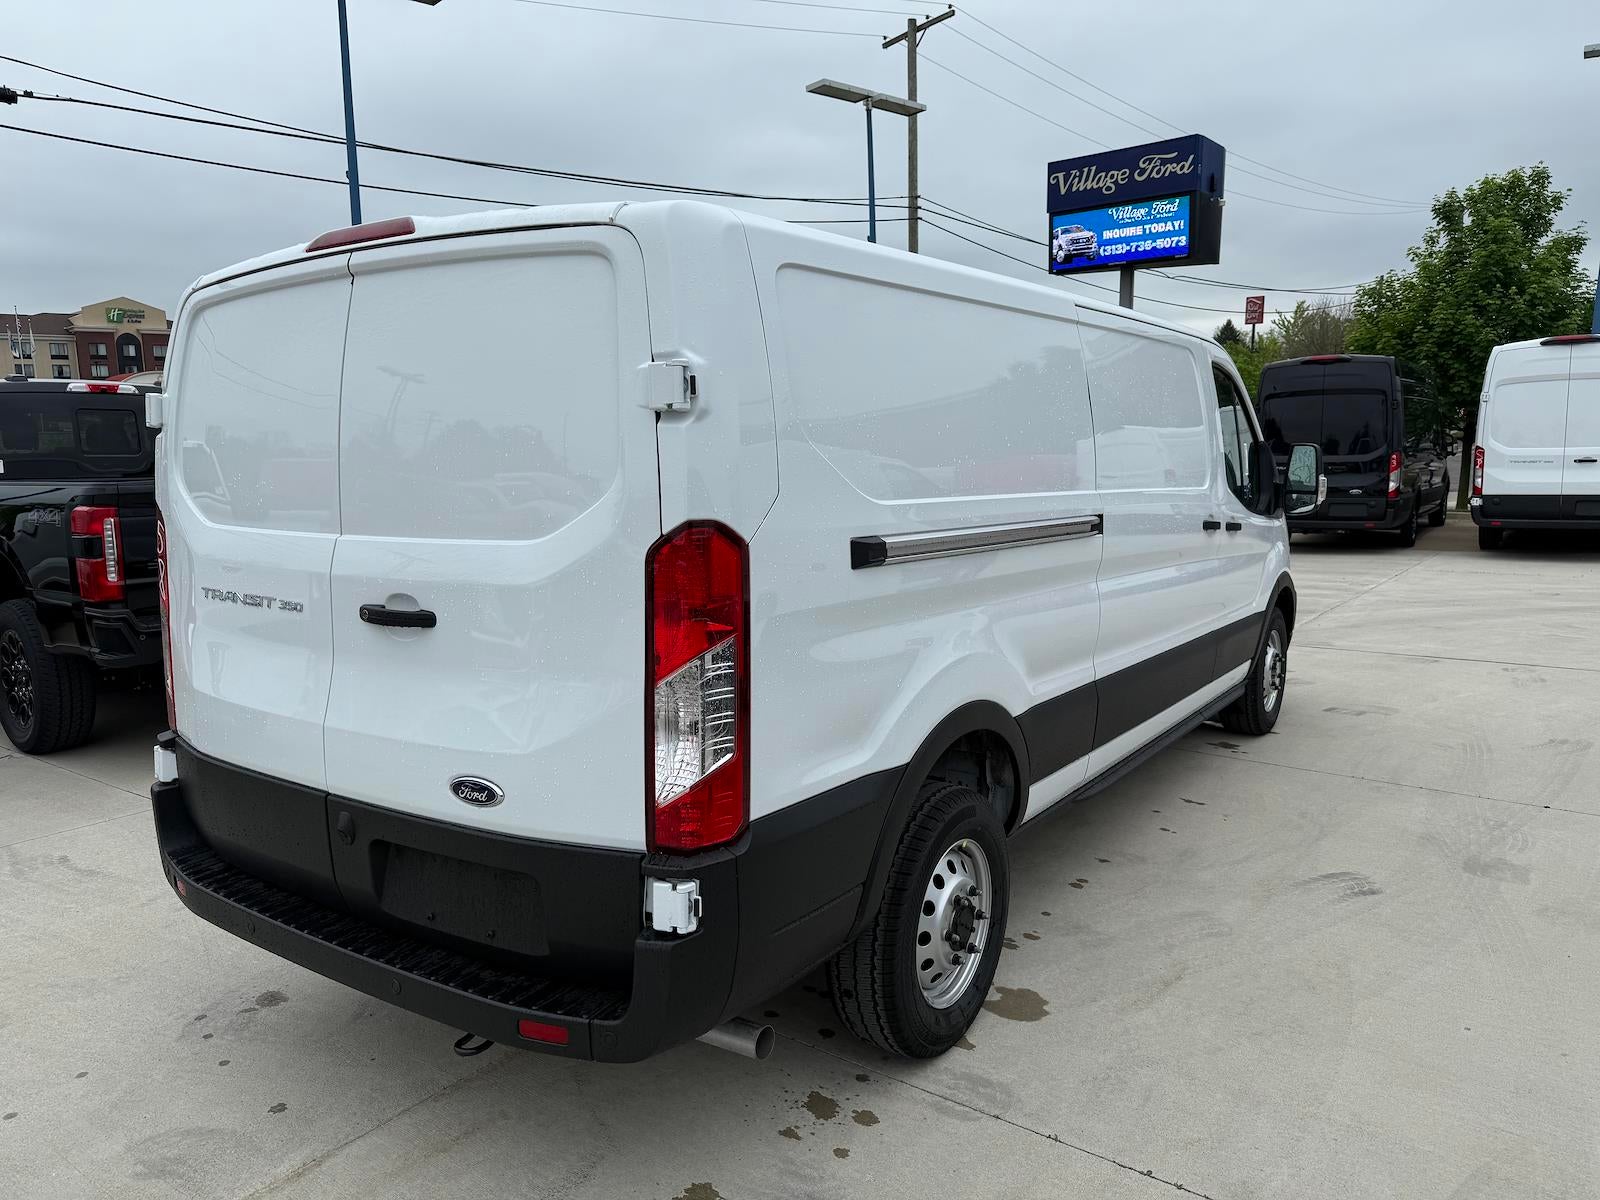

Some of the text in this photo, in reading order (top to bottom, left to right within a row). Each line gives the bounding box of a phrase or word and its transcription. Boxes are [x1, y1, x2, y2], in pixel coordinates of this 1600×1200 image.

[1050, 152, 1195, 195] Village Ford
[1108, 206, 1149, 220] Village
[1151, 199, 1180, 215] Ford
[1102, 219, 1185, 240] INQUIRE TODAY!
[201, 587, 277, 609] TRANSIT
[458, 782, 488, 801] Ford
